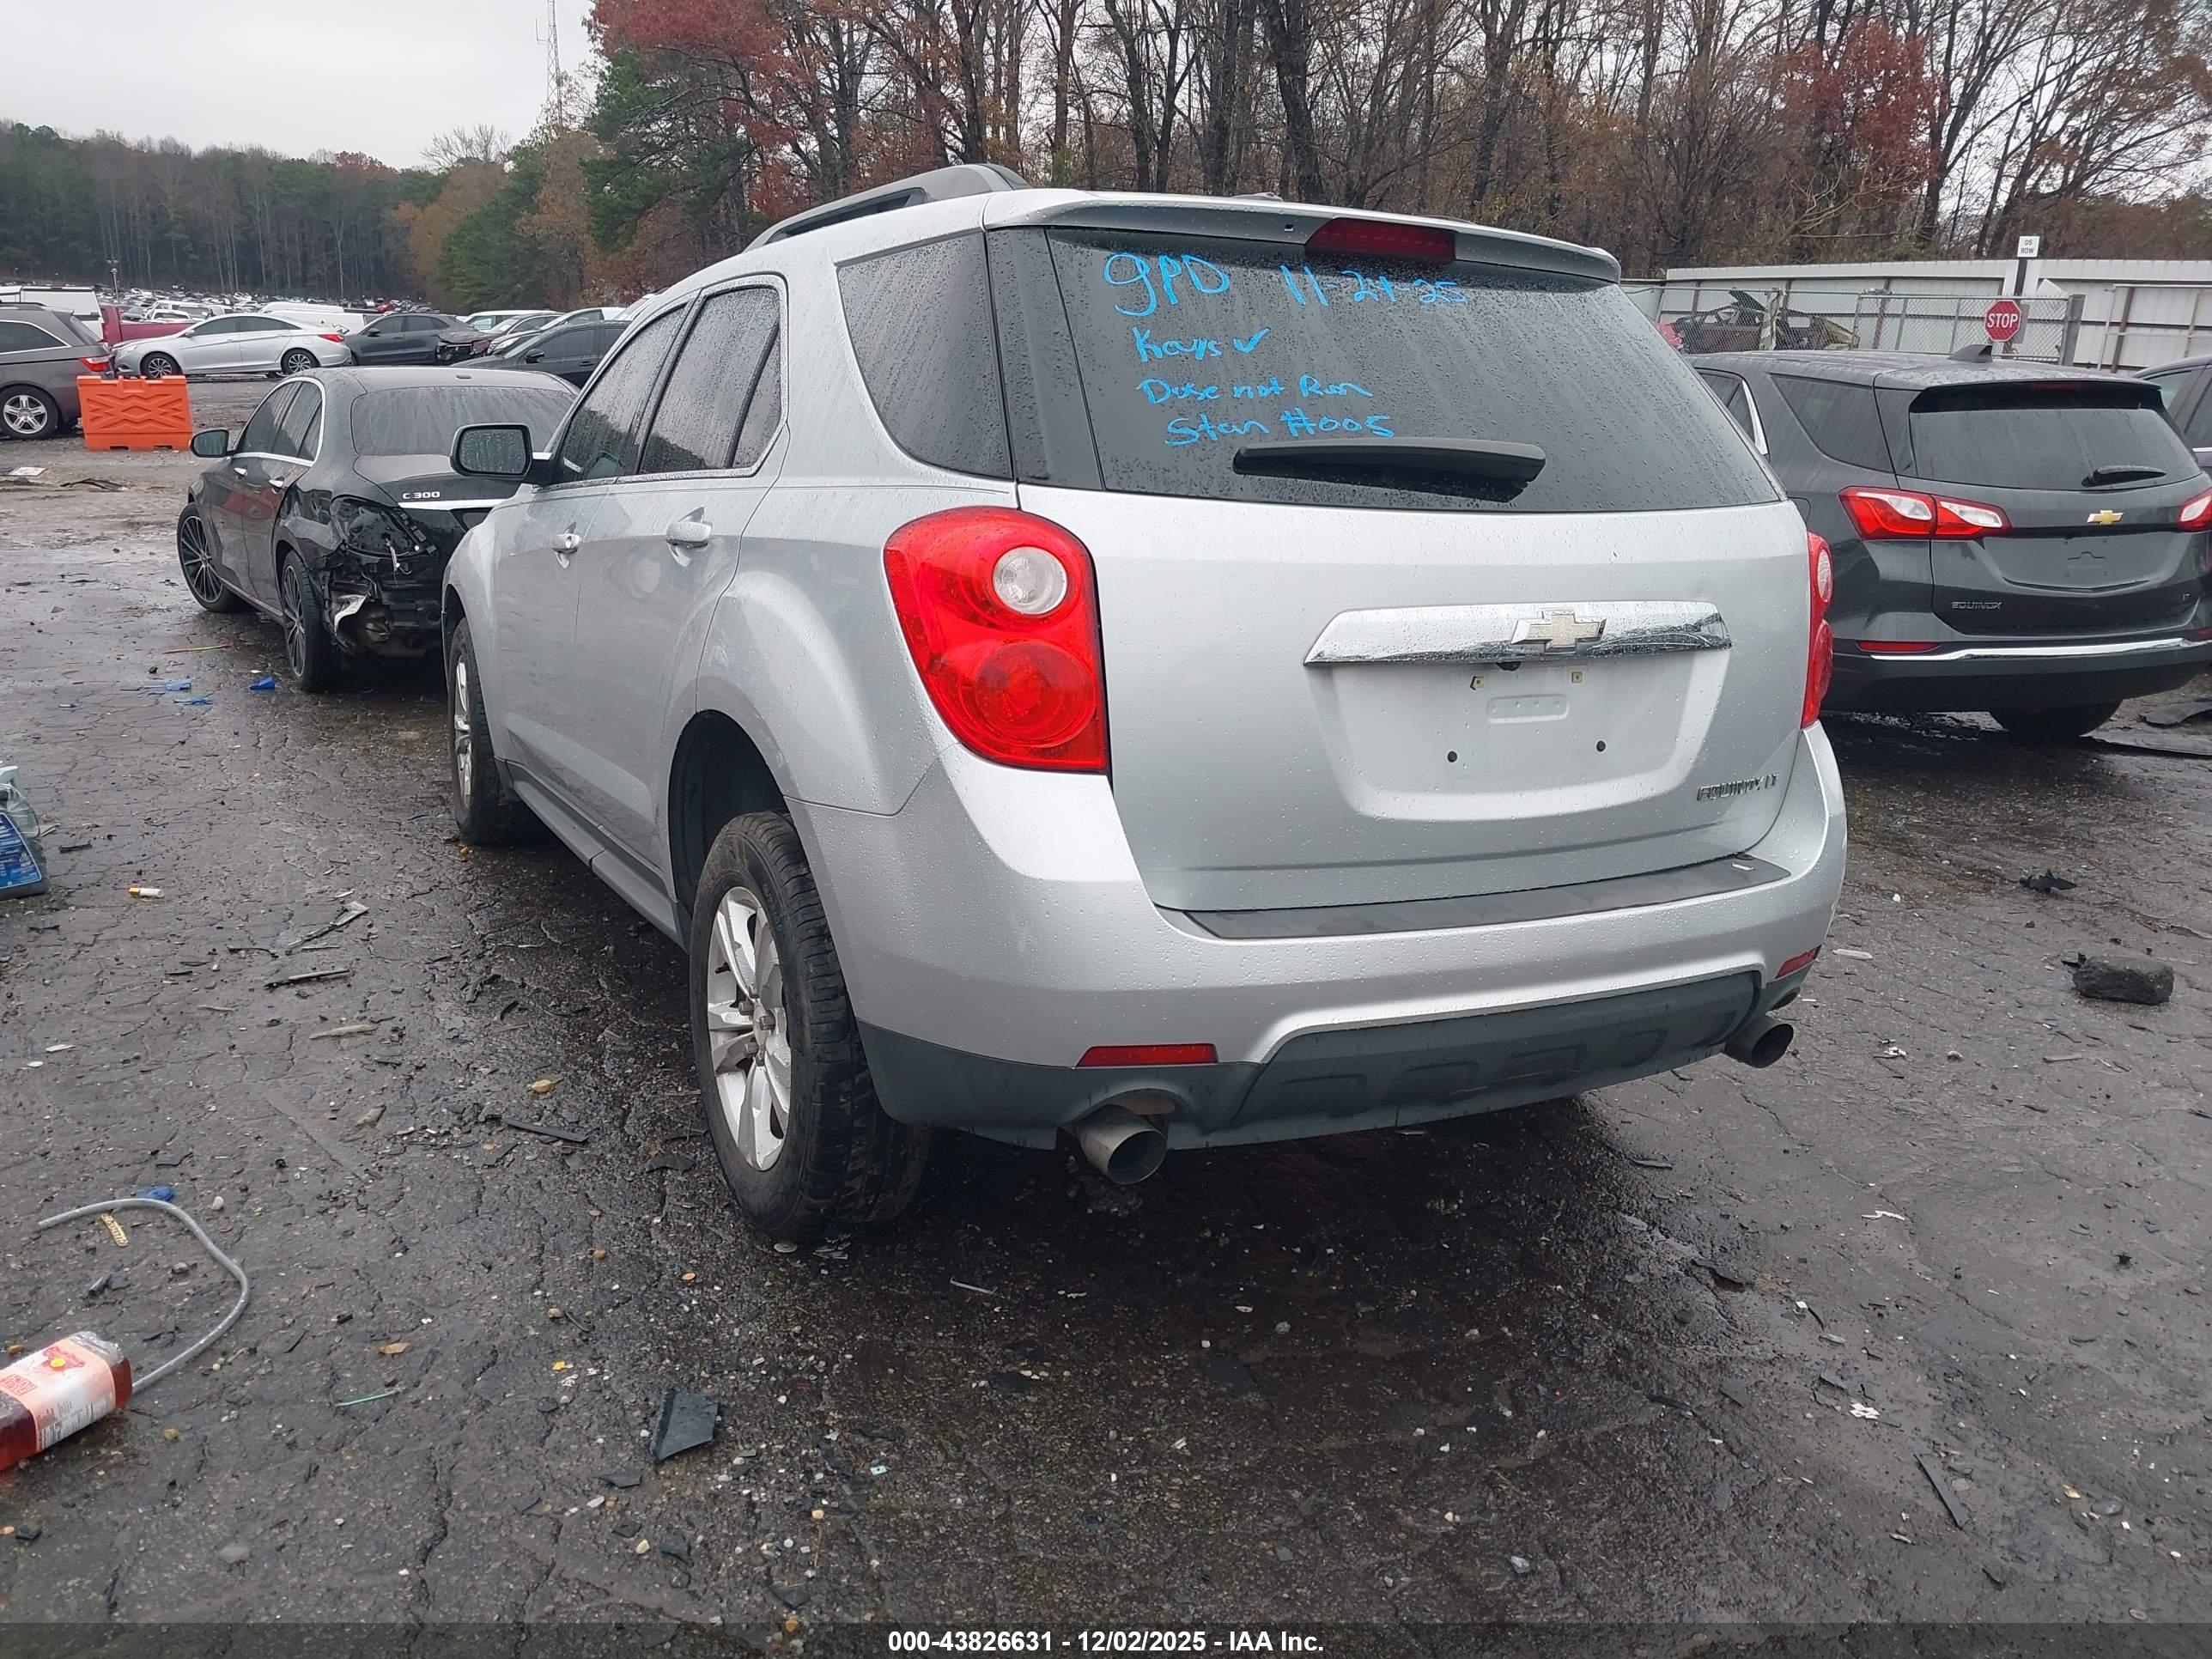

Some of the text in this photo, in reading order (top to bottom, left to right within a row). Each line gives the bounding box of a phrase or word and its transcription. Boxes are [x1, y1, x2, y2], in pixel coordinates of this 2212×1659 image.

[1986, 313, 2019, 329] STOP
[413, 490, 441, 499] 300
[1951, 600, 2002, 610] EQUINOX
[1696, 775, 1765, 801] EQUINOX
